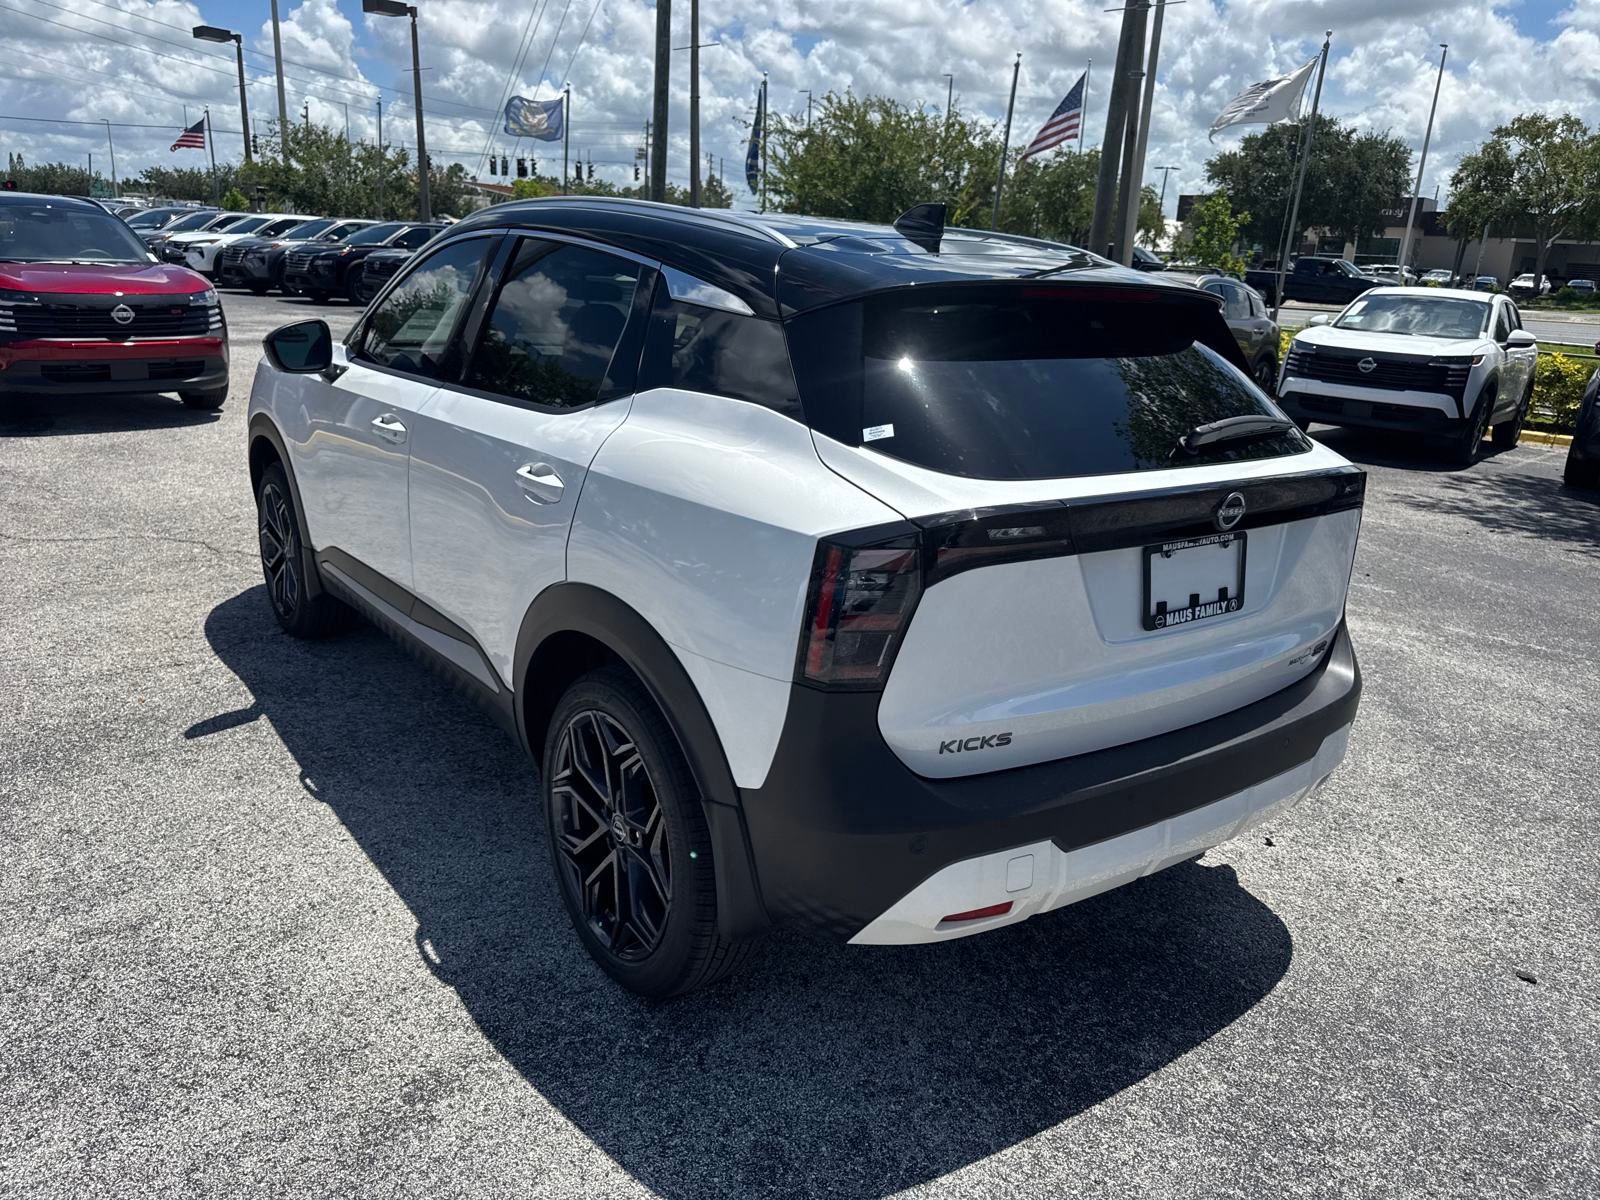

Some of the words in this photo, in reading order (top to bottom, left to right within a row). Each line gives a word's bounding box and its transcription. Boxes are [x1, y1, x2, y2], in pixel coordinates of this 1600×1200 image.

[1163, 534, 1235, 551] MAUSFAYAUTO.COM
[1166, 609, 1193, 626] MAUS
[1195, 601, 1228, 618] FAMILY
[939, 732, 1013, 755] KICKS
